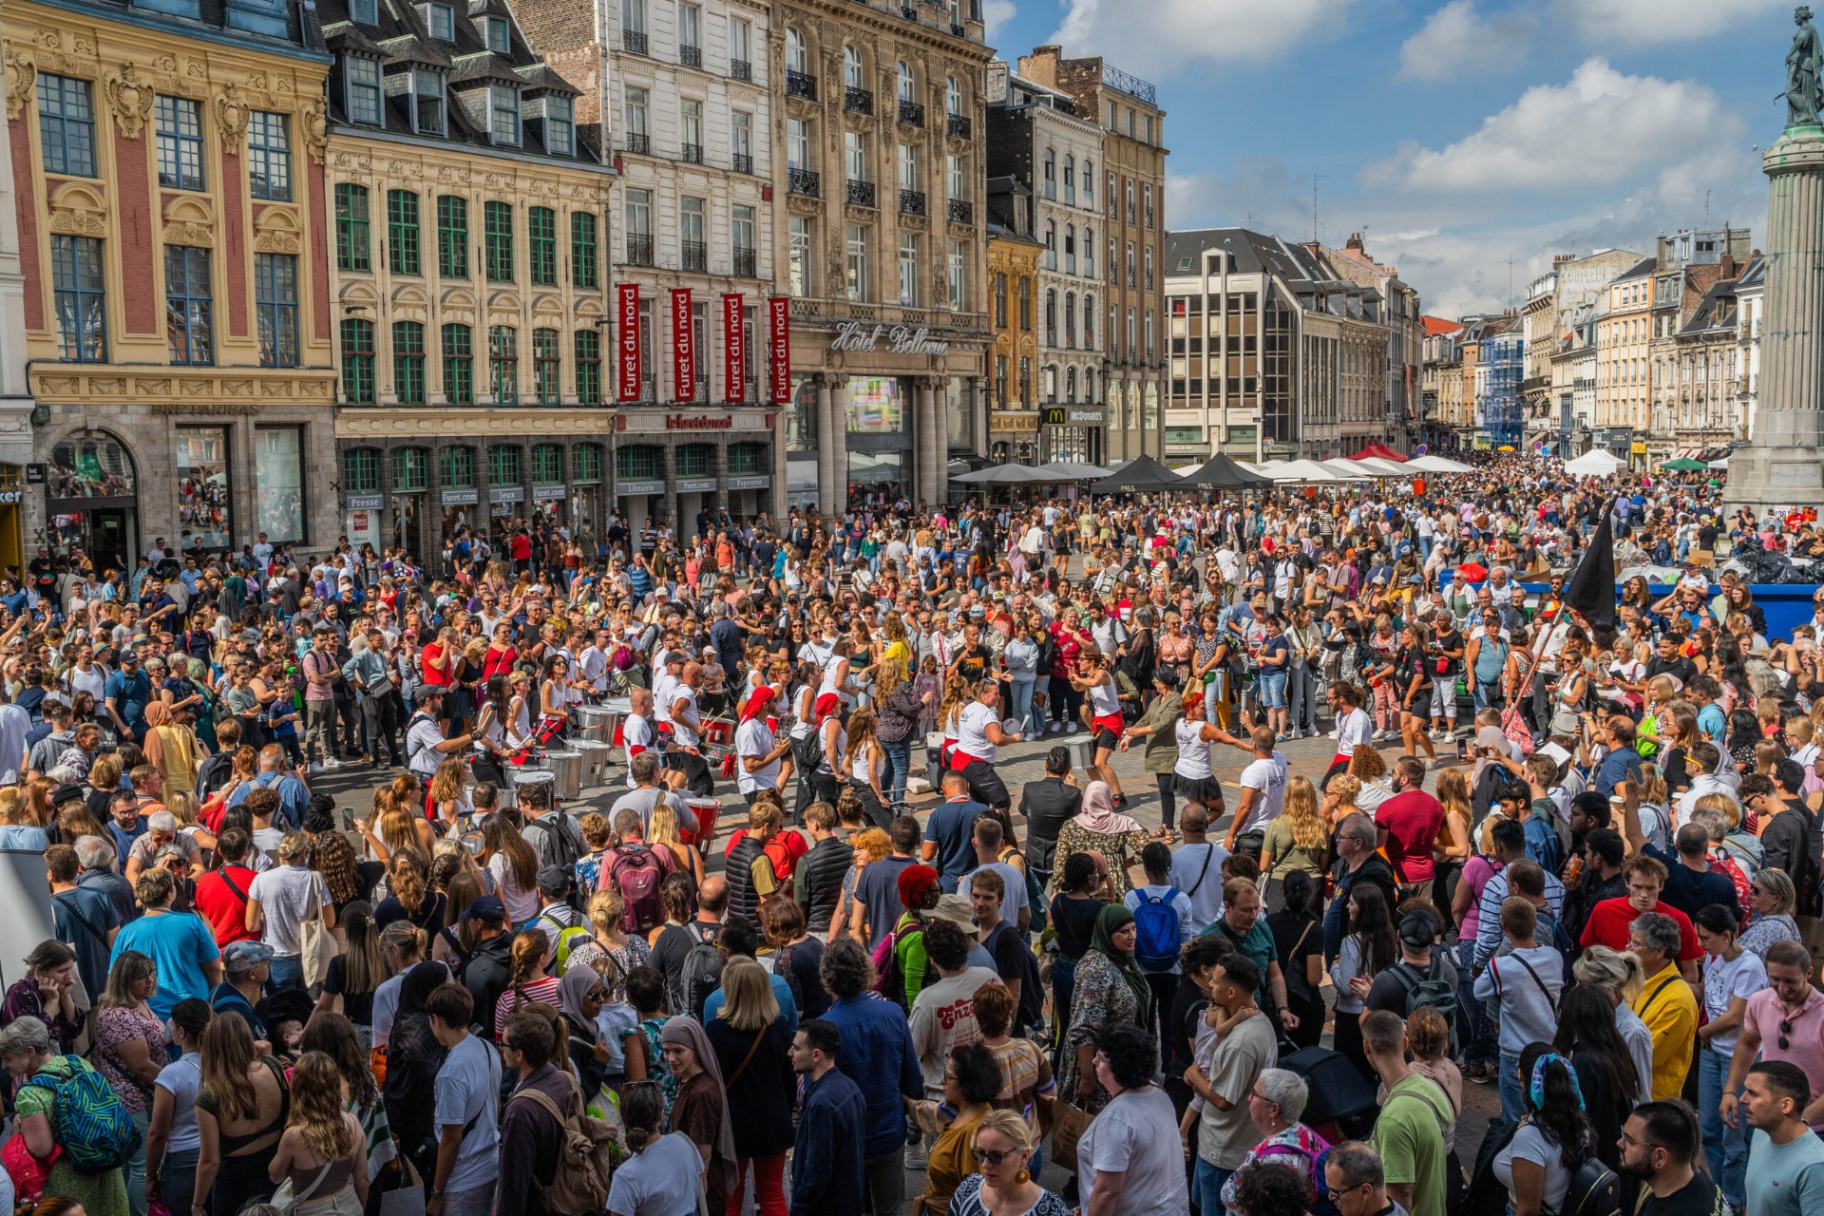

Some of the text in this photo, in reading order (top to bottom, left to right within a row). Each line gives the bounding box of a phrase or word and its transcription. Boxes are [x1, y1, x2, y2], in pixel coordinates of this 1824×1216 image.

[624, 289, 636, 397] Furet du nord
[676, 293, 690, 397] Furet du nord
[885, 325, 949, 356] Bellevue
[728, 298, 740, 398] Furet du nord
[774, 302, 787, 399] Furet du nord
[191, 404, 260, 416] PARIBAS
[628, 485, 654, 493] Librairie
[736, 479, 762, 488] Papeterie
[499, 491, 515, 500] Jeux
[533, 489, 565, 497] Furet.com
[351, 499, 379, 507] Presse
